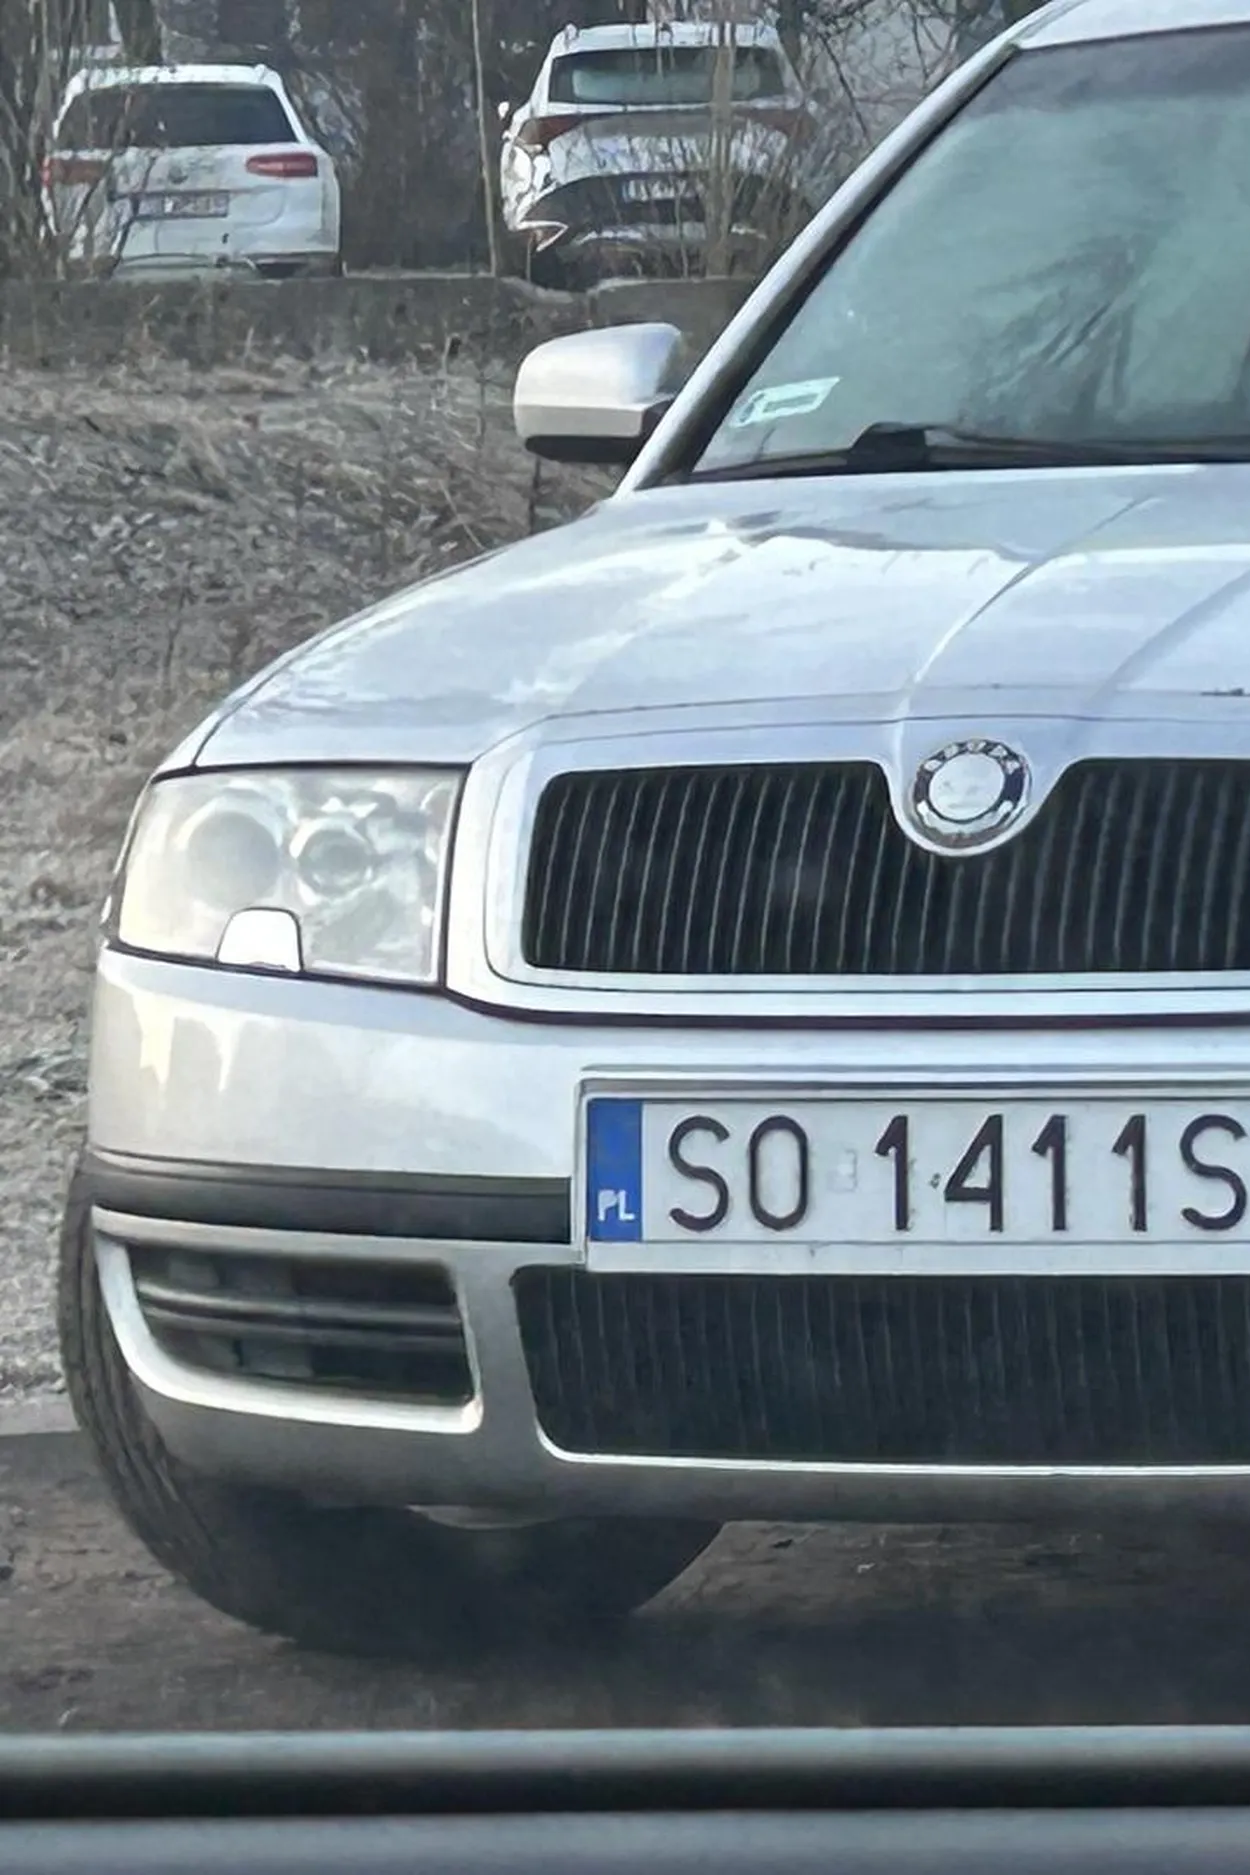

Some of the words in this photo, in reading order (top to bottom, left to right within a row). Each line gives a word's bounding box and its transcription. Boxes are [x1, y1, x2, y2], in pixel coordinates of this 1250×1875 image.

[597, 1189, 635, 1222] PL
[669, 1115, 809, 1232] SO
[875, 1114, 1248, 1231] 1411S
